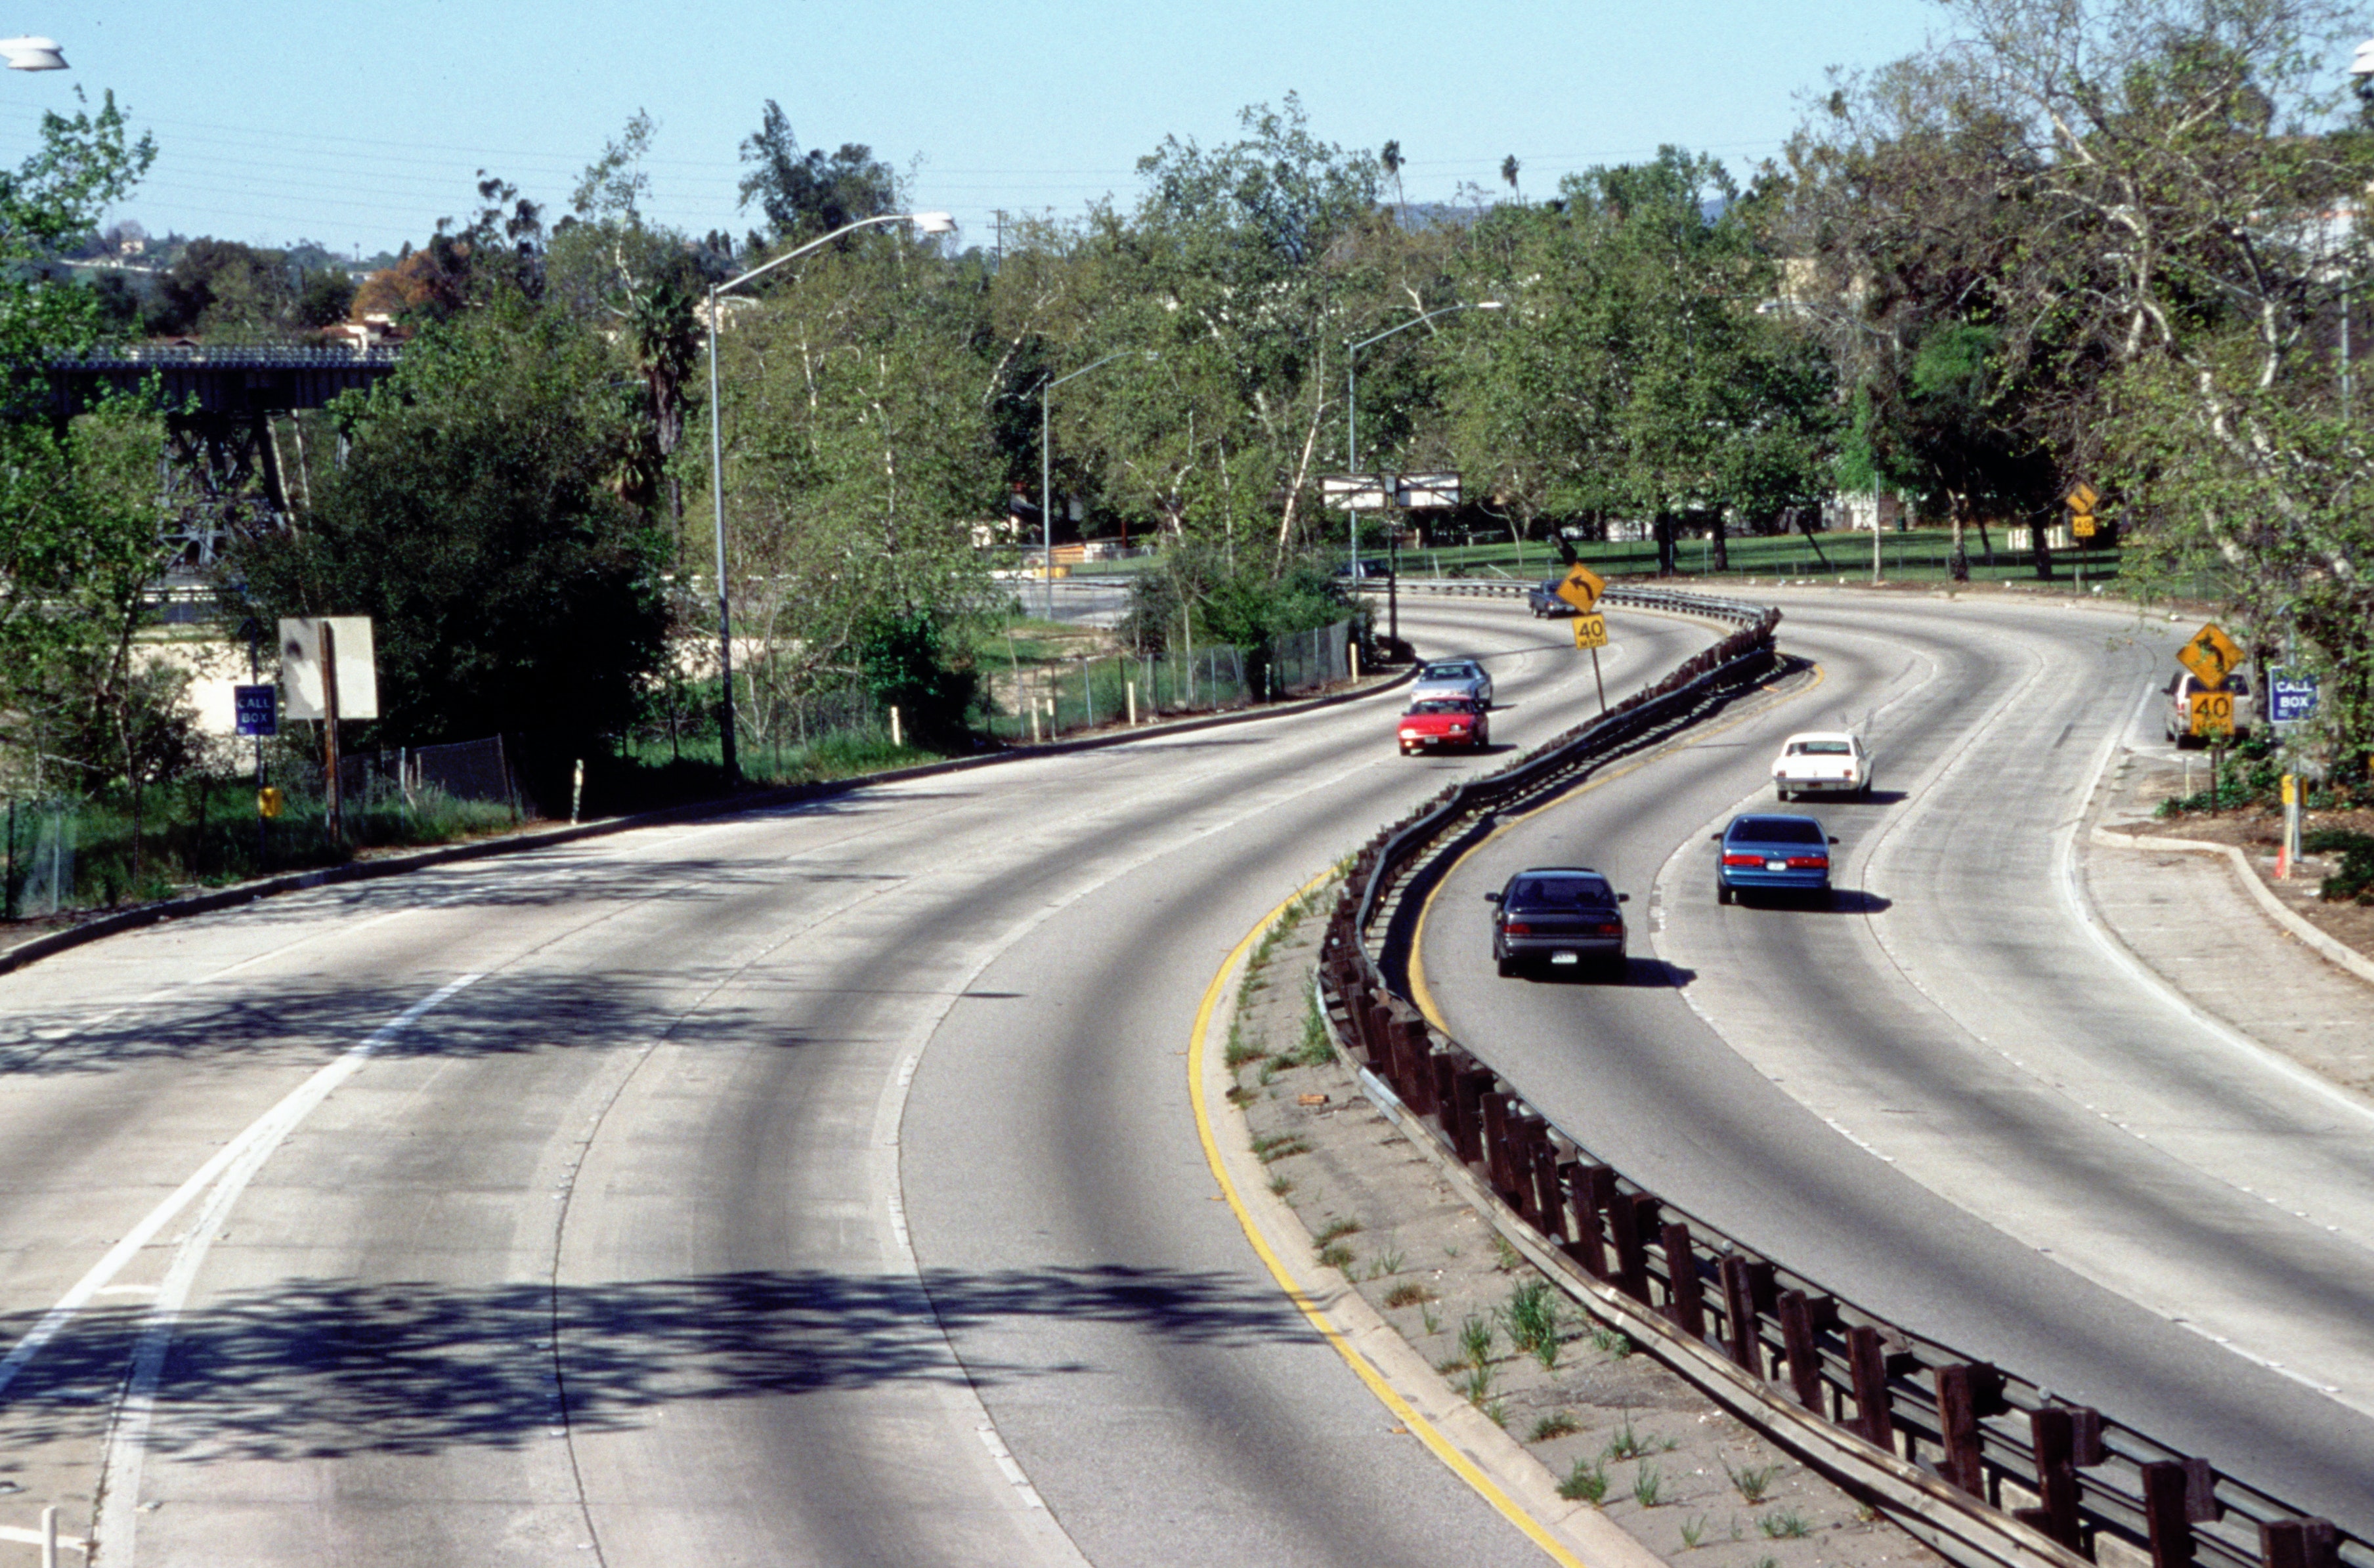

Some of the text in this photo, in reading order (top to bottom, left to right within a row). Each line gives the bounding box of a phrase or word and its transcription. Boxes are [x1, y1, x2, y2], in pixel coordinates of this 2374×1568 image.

[1579, 620, 1603, 638] 40
[1580, 639, 1603, 647] MPH
[2277, 681, 2312, 692] CALL
[237, 698, 270, 709] CALL
[2280, 696, 2308, 708] BOX
[2195, 697, 2229, 719] 40
[242, 713, 267, 723] BOX
